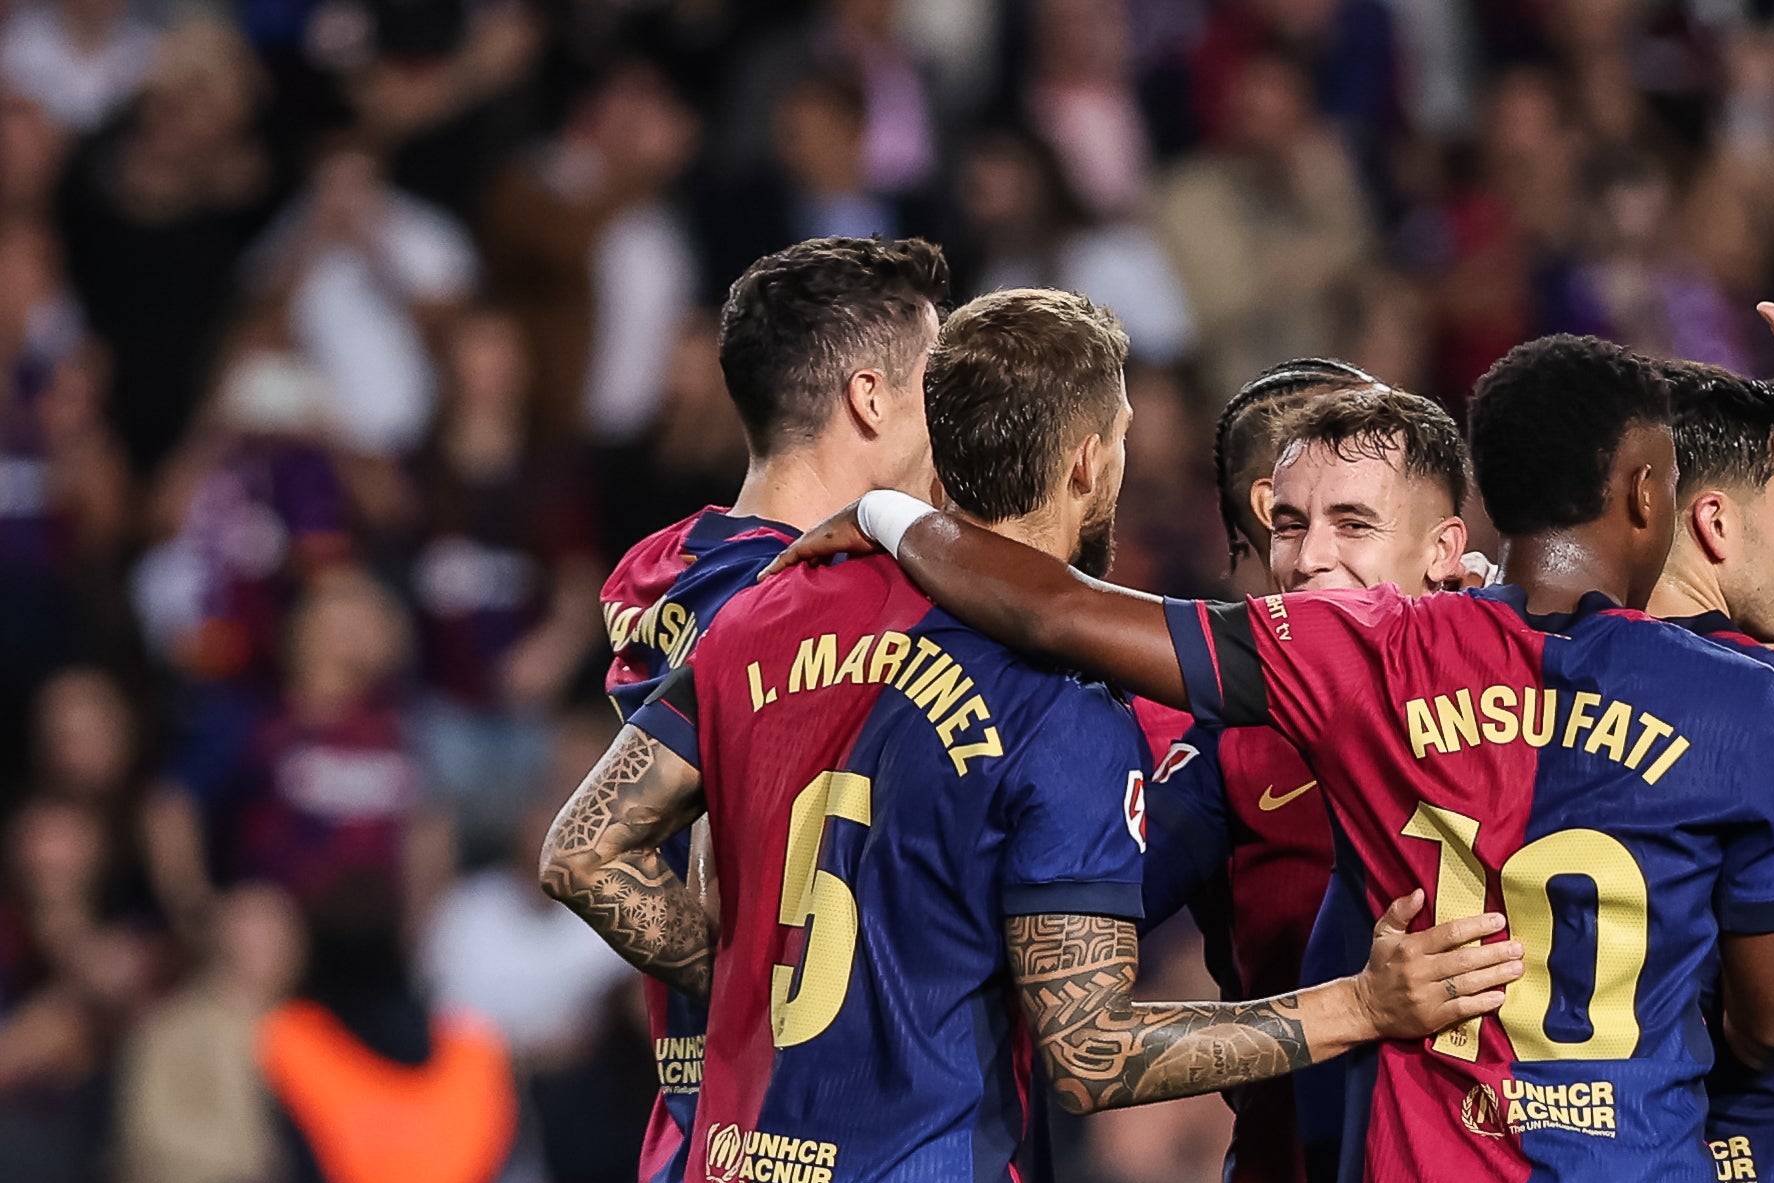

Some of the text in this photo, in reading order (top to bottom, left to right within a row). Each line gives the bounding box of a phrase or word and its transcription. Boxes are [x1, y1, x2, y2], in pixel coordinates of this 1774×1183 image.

[1276, 622, 1293, 640] tv
[747, 630, 1004, 777] I. MARTINEZ
[1405, 685, 1692, 786] ANSU FATI
[770, 770, 871, 1048] 5
[1400, 800, 1648, 1063] 10
[1502, 1079, 1614, 1107] UNHCR
[1507, 1101, 1616, 1130] ACNUR
[1509, 1124, 1526, 1135] The
[1526, 1120, 1541, 1131] UN
[744, 1130, 837, 1168] UNHCR
